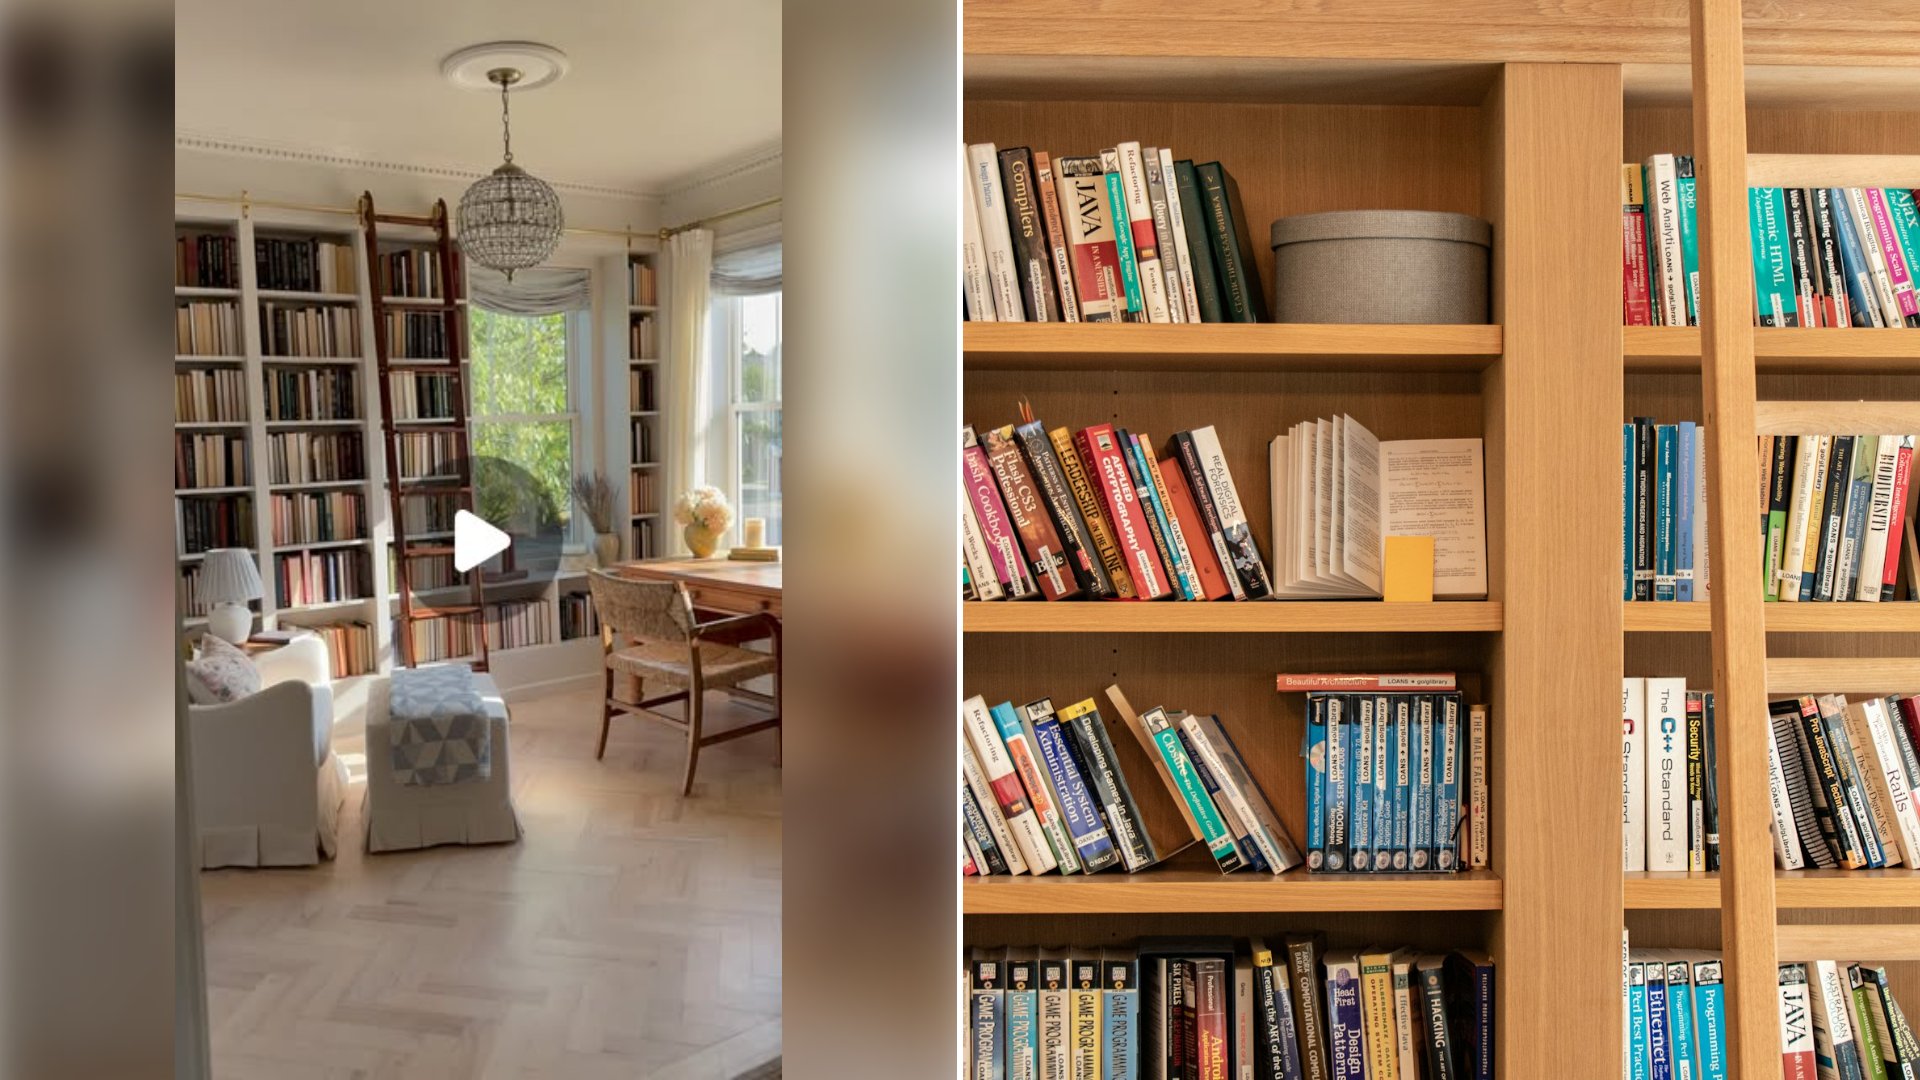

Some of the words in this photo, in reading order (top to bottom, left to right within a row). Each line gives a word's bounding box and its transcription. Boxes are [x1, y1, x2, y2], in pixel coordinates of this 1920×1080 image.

[1127, 149, 1141, 204] Refactoring
[1661, 180, 1670, 204] Web
[1011, 161, 1034, 237] Compilers
[1075, 181, 1102, 237] JAVA
[1111, 177, 1123, 220] Programming
[1686, 182, 1697, 209] Dojo
[1790, 190, 1799, 208] Web
[1818, 190, 1827, 208] Web
[1897, 190, 1919, 228] Ajax
[1153, 200, 1166, 233] jQuery
[1792, 209, 1802, 238] Testing
[1820, 209, 1830, 238] Testing
[1118, 221, 1127, 246] Google
[1160, 233, 1168, 245] in
[1862, 221, 1877, 254] Blogging
[1867, 188, 1896, 252] Programming
[1888, 252, 1904, 277] Scala
[1894, 208, 1910, 246] Definitive
[1908, 247, 1919, 272] Guide
[1055, 249, 1067, 275] LOANS
[1121, 246, 1130, 261] App
[1161, 246, 1173, 271] Action
[1665, 247, 1673, 273] LOANS
[1770, 245, 1785, 287] HTML
[1094, 261, 1106, 297] NUTSHELL
[1149, 267, 1157, 294] Fowler
[966, 451, 983, 483] bash
[1004, 450, 1022, 480] Flash
[1019, 484, 1036, 512] CS3
[1111, 455, 1133, 503] APPLIED
[1833, 472, 1841, 482] of
[1896, 452, 1907, 489] Collective
[993, 455, 1030, 528] Professional
[1060, 448, 1099, 519] LEADERSHIP
[1194, 476, 1210, 504] Software
[1209, 469, 1232, 520] FORENSICS
[1212, 455, 1224, 476] REAL
[1221, 480, 1237, 517] DIGITAL
[1774, 475, 1782, 502] Usability
[1871, 454, 1895, 532] BIODIVERSITY
[1102, 456, 1139, 550] CRYPTOGRAPHY
[1890, 488, 1901, 525] Intelligence
[1095, 533, 1107, 548] THE
[1829, 517, 1840, 543] LOANS
[968, 536, 979, 561] Weeks
[976, 566, 984, 579] Tate
[1002, 539, 1012, 561] LOANS
[1100, 545, 1120, 575] LINE
[1844, 538, 1852, 560] LOANS
[1286, 677, 1320, 686] Beautiful
[1321, 678, 1367, 686] Architecture
[1661, 688, 1669, 713] The
[973, 709, 999, 763] Refactoring
[1473, 715, 1483, 730] THE
[1660, 717, 1676, 753] C++
[1161, 733, 1187, 777] Closure
[1473, 737, 1483, 761] MALE
[1688, 720, 1700, 761] Security
[1809, 717, 1819, 733] Pro
[1814, 734, 1835, 779] JavaScript
[1049, 722, 1078, 780] Essential
[1072, 780, 1097, 828] System
[1855, 752, 1867, 770] The
[1037, 730, 1080, 824] Administration
[1082, 718, 1107, 769] Developing
[1103, 771, 1121, 804] Games
[1122, 813, 1136, 839] Java
[1860, 768, 1874, 792] New
[1887, 768, 1907, 813] Rails
[1661, 758, 1673, 841] Standard
[1771, 786, 1780, 809] LOANS
[1850, 787, 1863, 812] LOANS
[1867, 790, 1883, 821] Digital
[990, 806, 1003, 827] LOANS
[1044, 809, 1057, 831] LOANS
[1328, 807, 1336, 844] Introducing
[1336, 801, 1344, 844] WINDOWS
[1842, 808, 1852, 829] LOANS
[1876, 819, 1889, 837] Age
[1173, 963, 1181, 977] SIX
[1173, 978, 1182, 1006] PIXELS
[1264, 969, 1272, 1009] Creating
[1333, 987, 1355, 996] Head
[1335, 998, 1355, 1006] First
[1370, 979, 1378, 1028] OPERATING
[1632, 991, 1643, 1012] Perl
[979, 994, 996, 1020] GAME
[1013, 994, 1029, 1018] GAME
[1046, 996, 1061, 1019] GAME
[1079, 994, 1094, 1018] GAME
[1112, 995, 1127, 1018] GAME
[1300, 976, 1316, 1049] COMPUTATIONAL
[1378, 979, 1388, 1039] SILBERSCHATZ
[1676, 991, 1685, 1041] Programming
[1783, 990, 1806, 1048] JAVA
[1828, 972, 1849, 1038] AUSTRALIAN
[1270, 1026, 1278, 1042] ART
[1278, 1017, 1289, 1055] Programming
[1430, 999, 1445, 1048] HACKING
[1634, 1017, 1643, 1040] Best
[1650, 990, 1665, 1064] Ethernet
[1705, 990, 1720, 1071] Programming
[1858, 992, 1873, 1043] Programming
[1870, 1044, 1882, 1074] Android
[1173, 1020, 1182, 1066] SEPARATION
[1348, 1029, 1361, 1075] Design
[1272, 1055, 1281, 1070] the
[1283, 1055, 1291, 1072] Guide
[1795, 1055, 1802, 1063] IN
